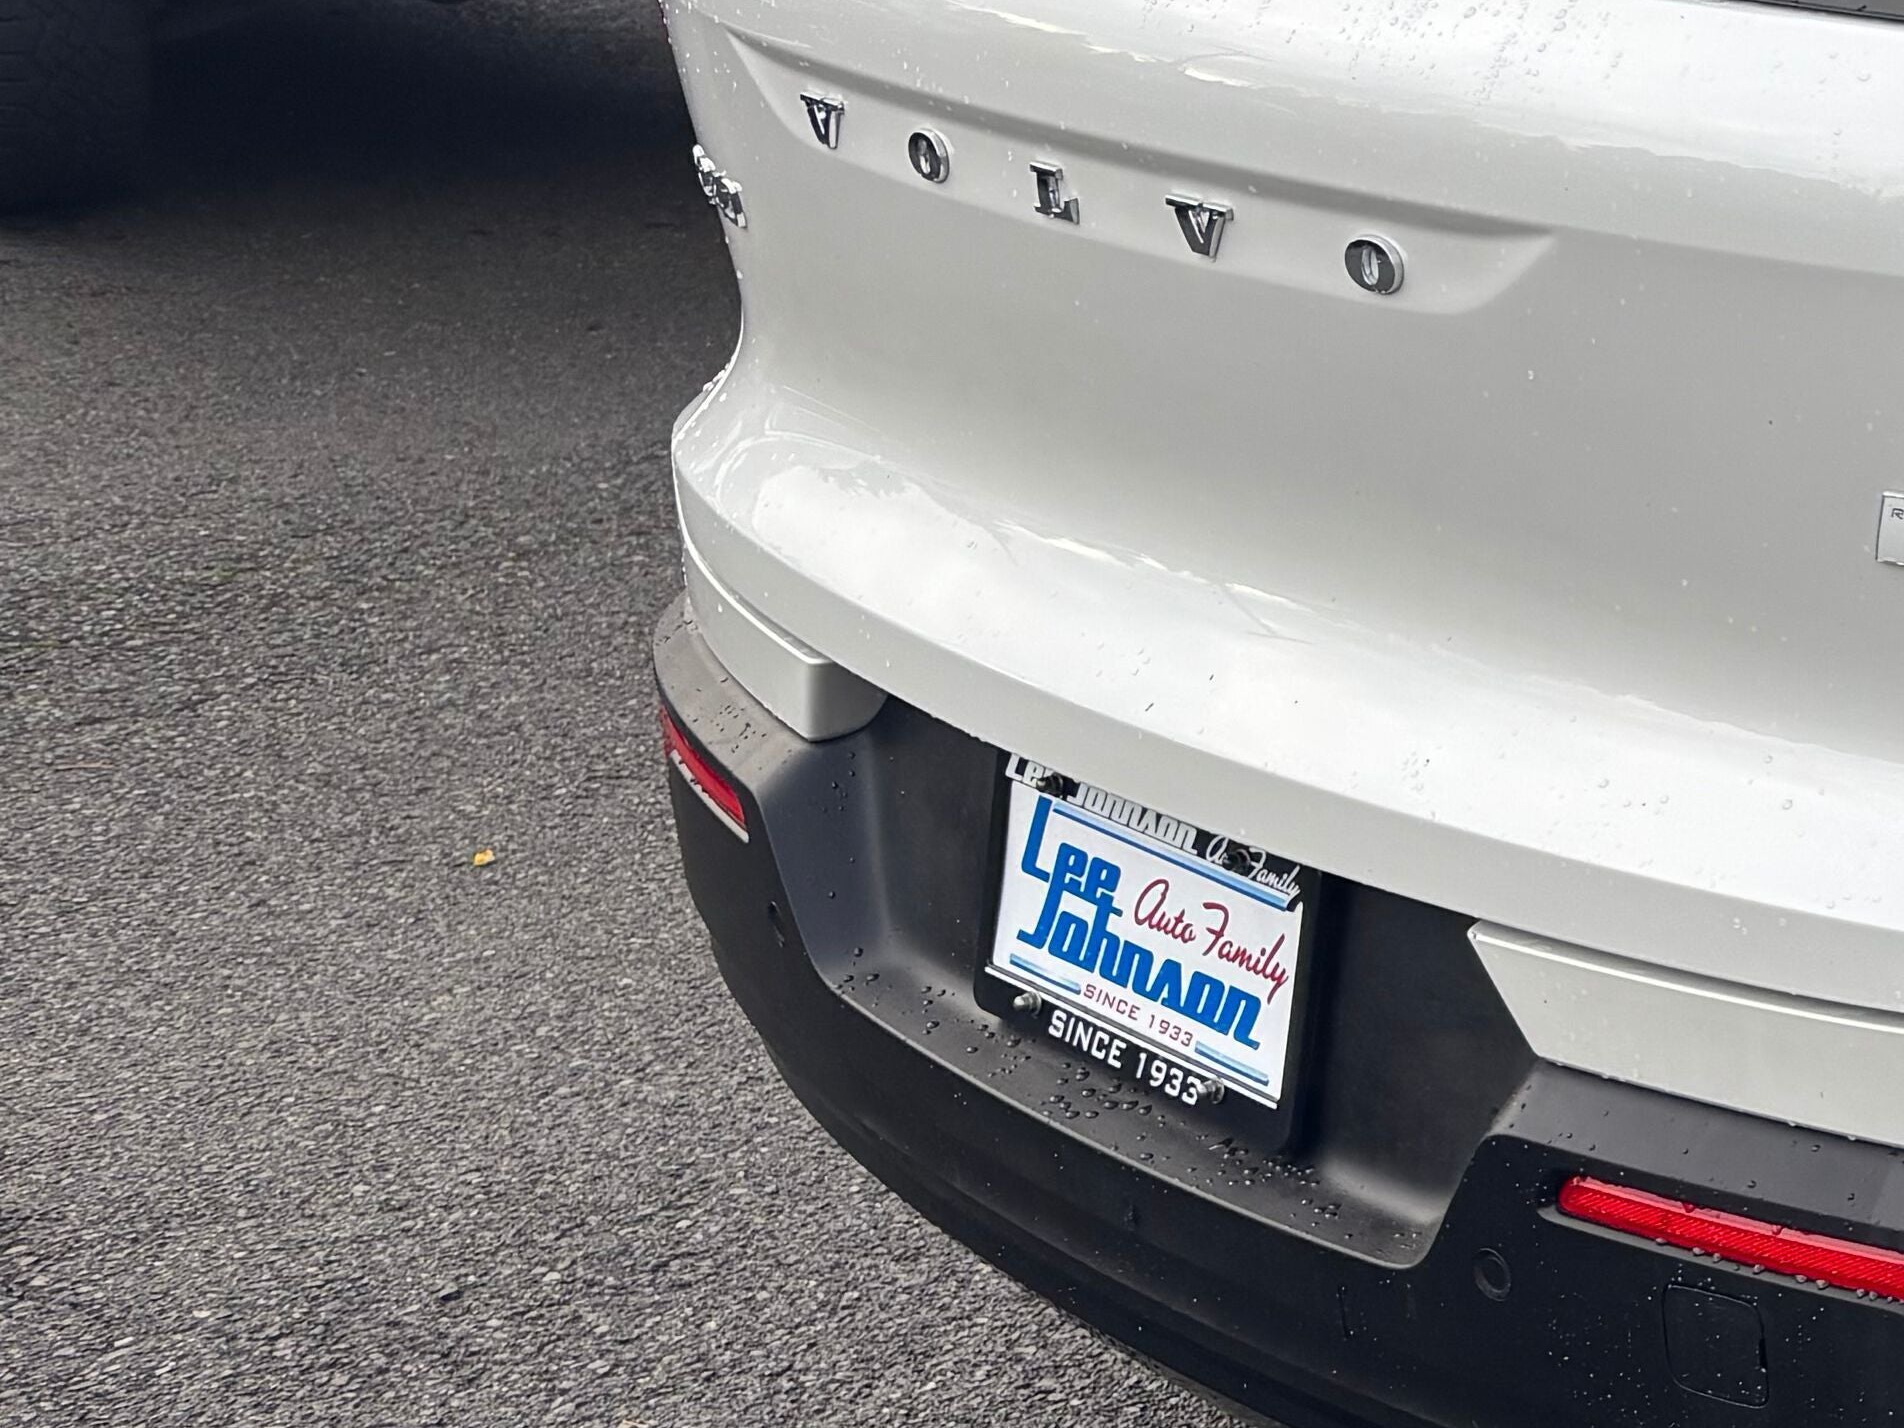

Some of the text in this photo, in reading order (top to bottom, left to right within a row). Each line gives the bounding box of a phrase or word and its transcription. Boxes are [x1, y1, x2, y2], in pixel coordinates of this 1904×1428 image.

[800, 91, 1405, 296] VOLVO
[1021, 795, 1122, 903] Lee
[1016, 888, 1261, 1050] Johnson
[1134, 878, 1289, 1005] Auto Family
[1048, 1009, 1201, 1106] SINCE 1933
[1083, 983, 1194, 1048] SINCE 1933
